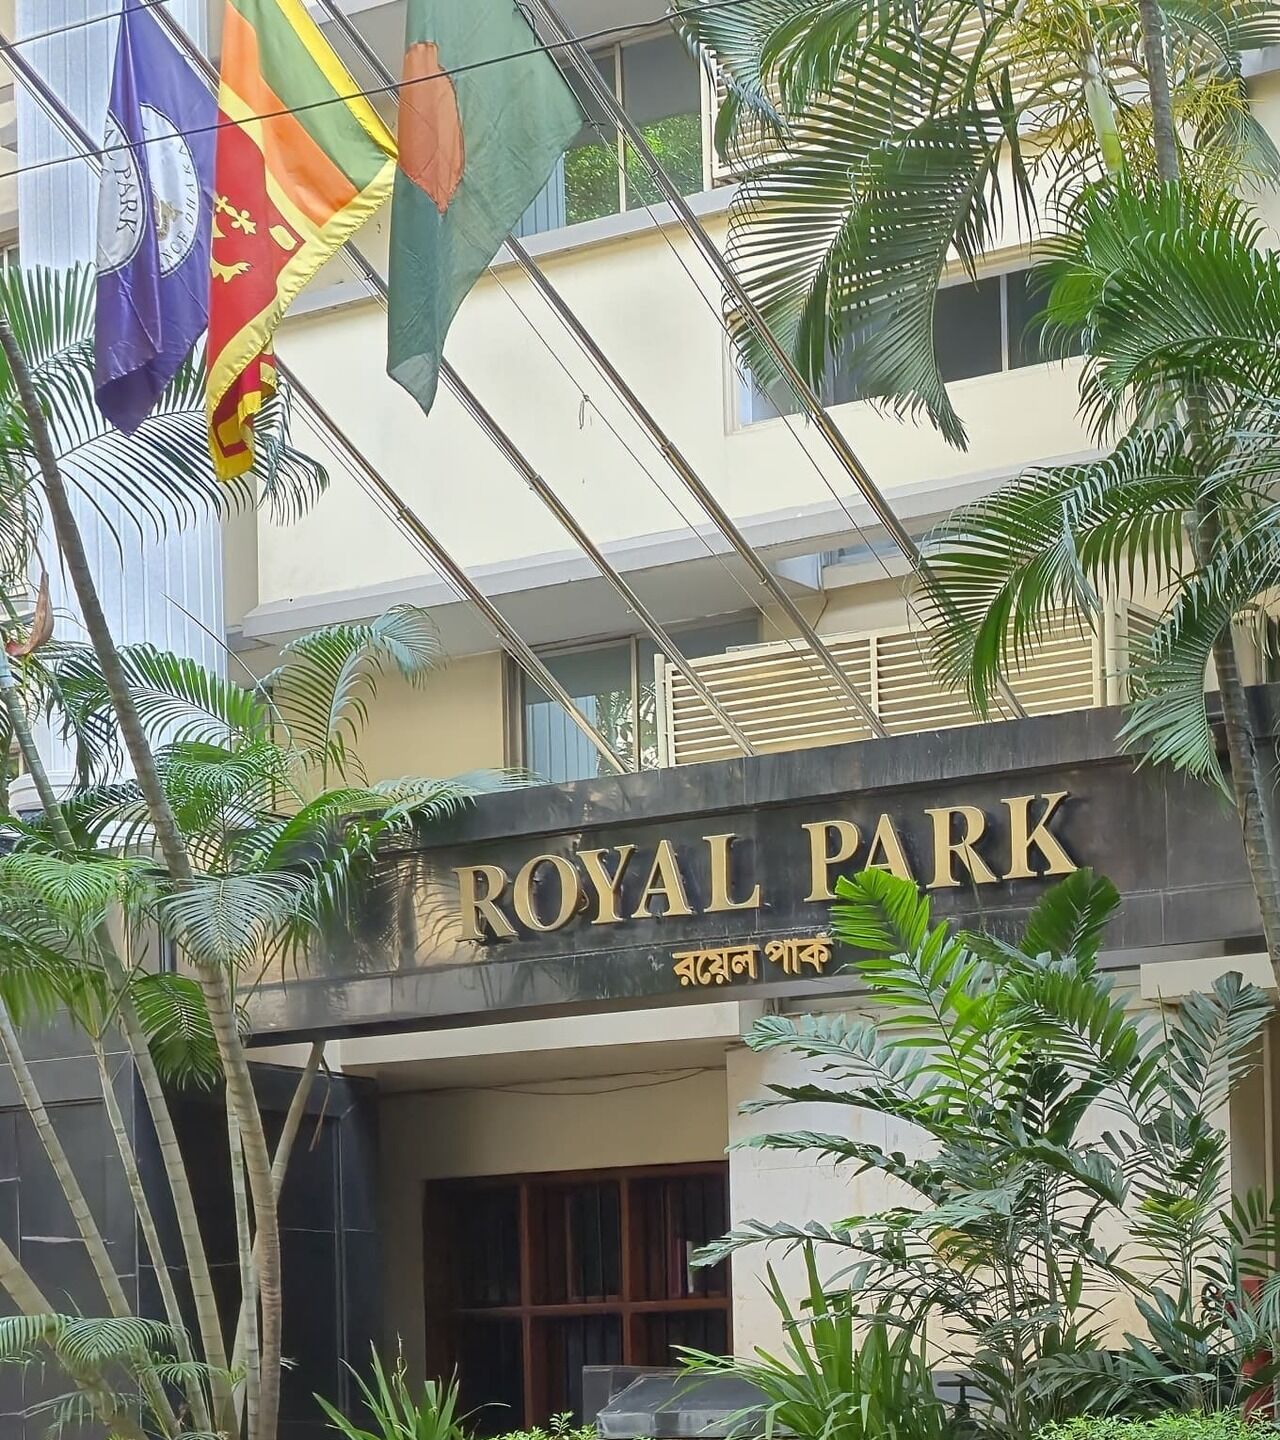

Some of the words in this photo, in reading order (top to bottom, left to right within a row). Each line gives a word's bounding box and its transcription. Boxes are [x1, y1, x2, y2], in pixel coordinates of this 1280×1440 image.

[114, 168, 138, 234] PARK
[452, 832, 762, 943] ROYAL
[800, 790, 1080, 904] PARK
[672, 943, 761, 987] রয়েল
